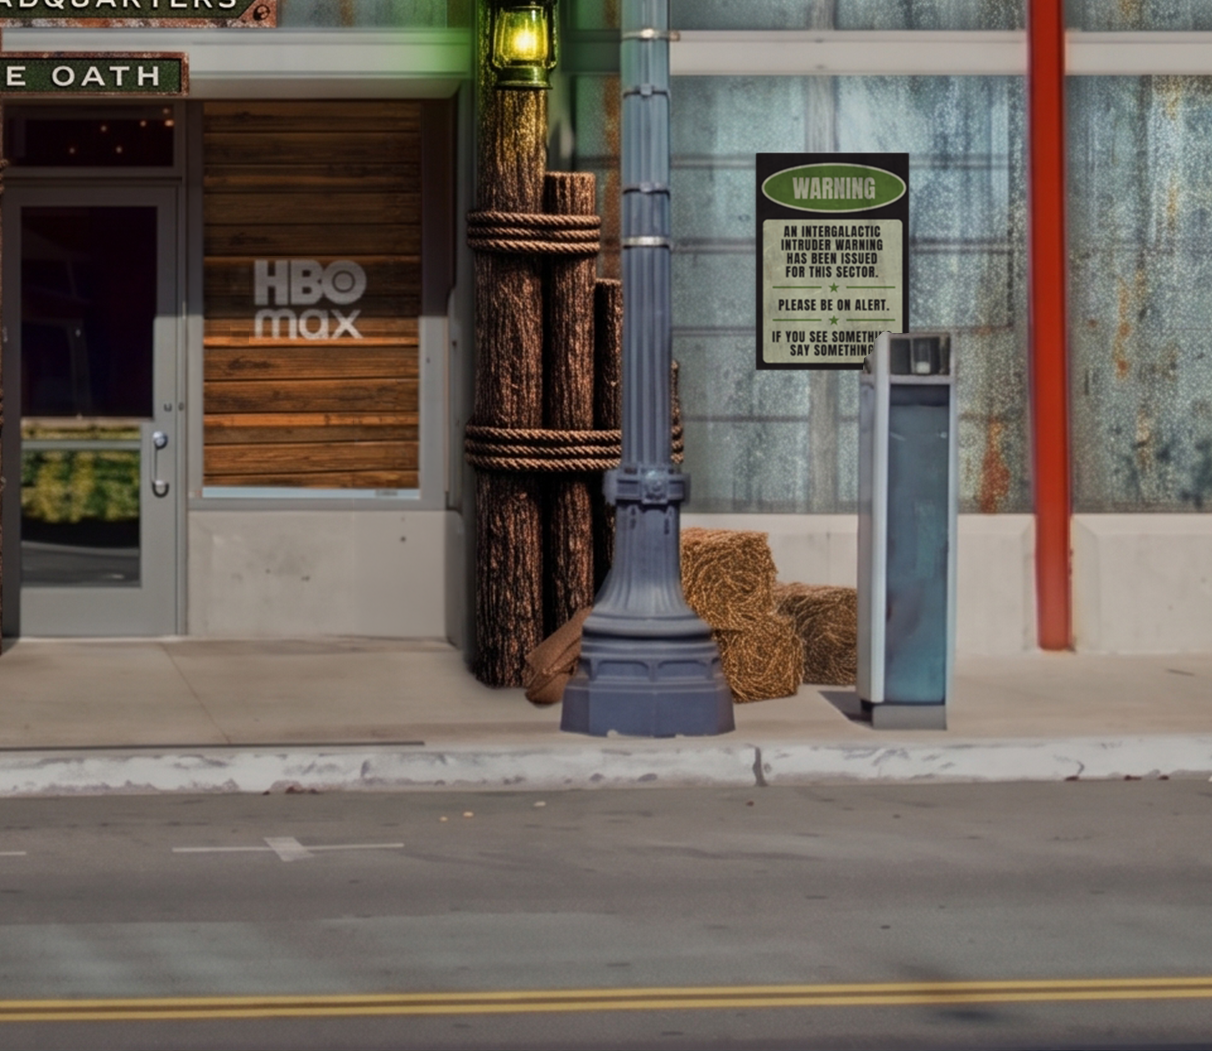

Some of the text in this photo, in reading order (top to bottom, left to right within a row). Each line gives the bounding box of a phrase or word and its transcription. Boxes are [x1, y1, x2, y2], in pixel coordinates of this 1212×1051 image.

[51, 64, 160, 88] OATH
[792, 176, 876, 200] WARNING
[784, 226, 881, 238] AN INTERGALACTIC
[781, 239, 883, 251] INTRUDER WARNING
[786, 253, 878, 264] HAS BEEN ISSUED
[785, 266, 879, 278] FOR THIS SECTOR.
[254, 259, 367, 305] HBO
[778, 299, 890, 311] PLEASE BE ON ALERT.
[254, 309, 364, 340] max
[772, 331, 892, 343] IF YOU SEE SOMETHI
[790, 344, 810, 356] SAY
